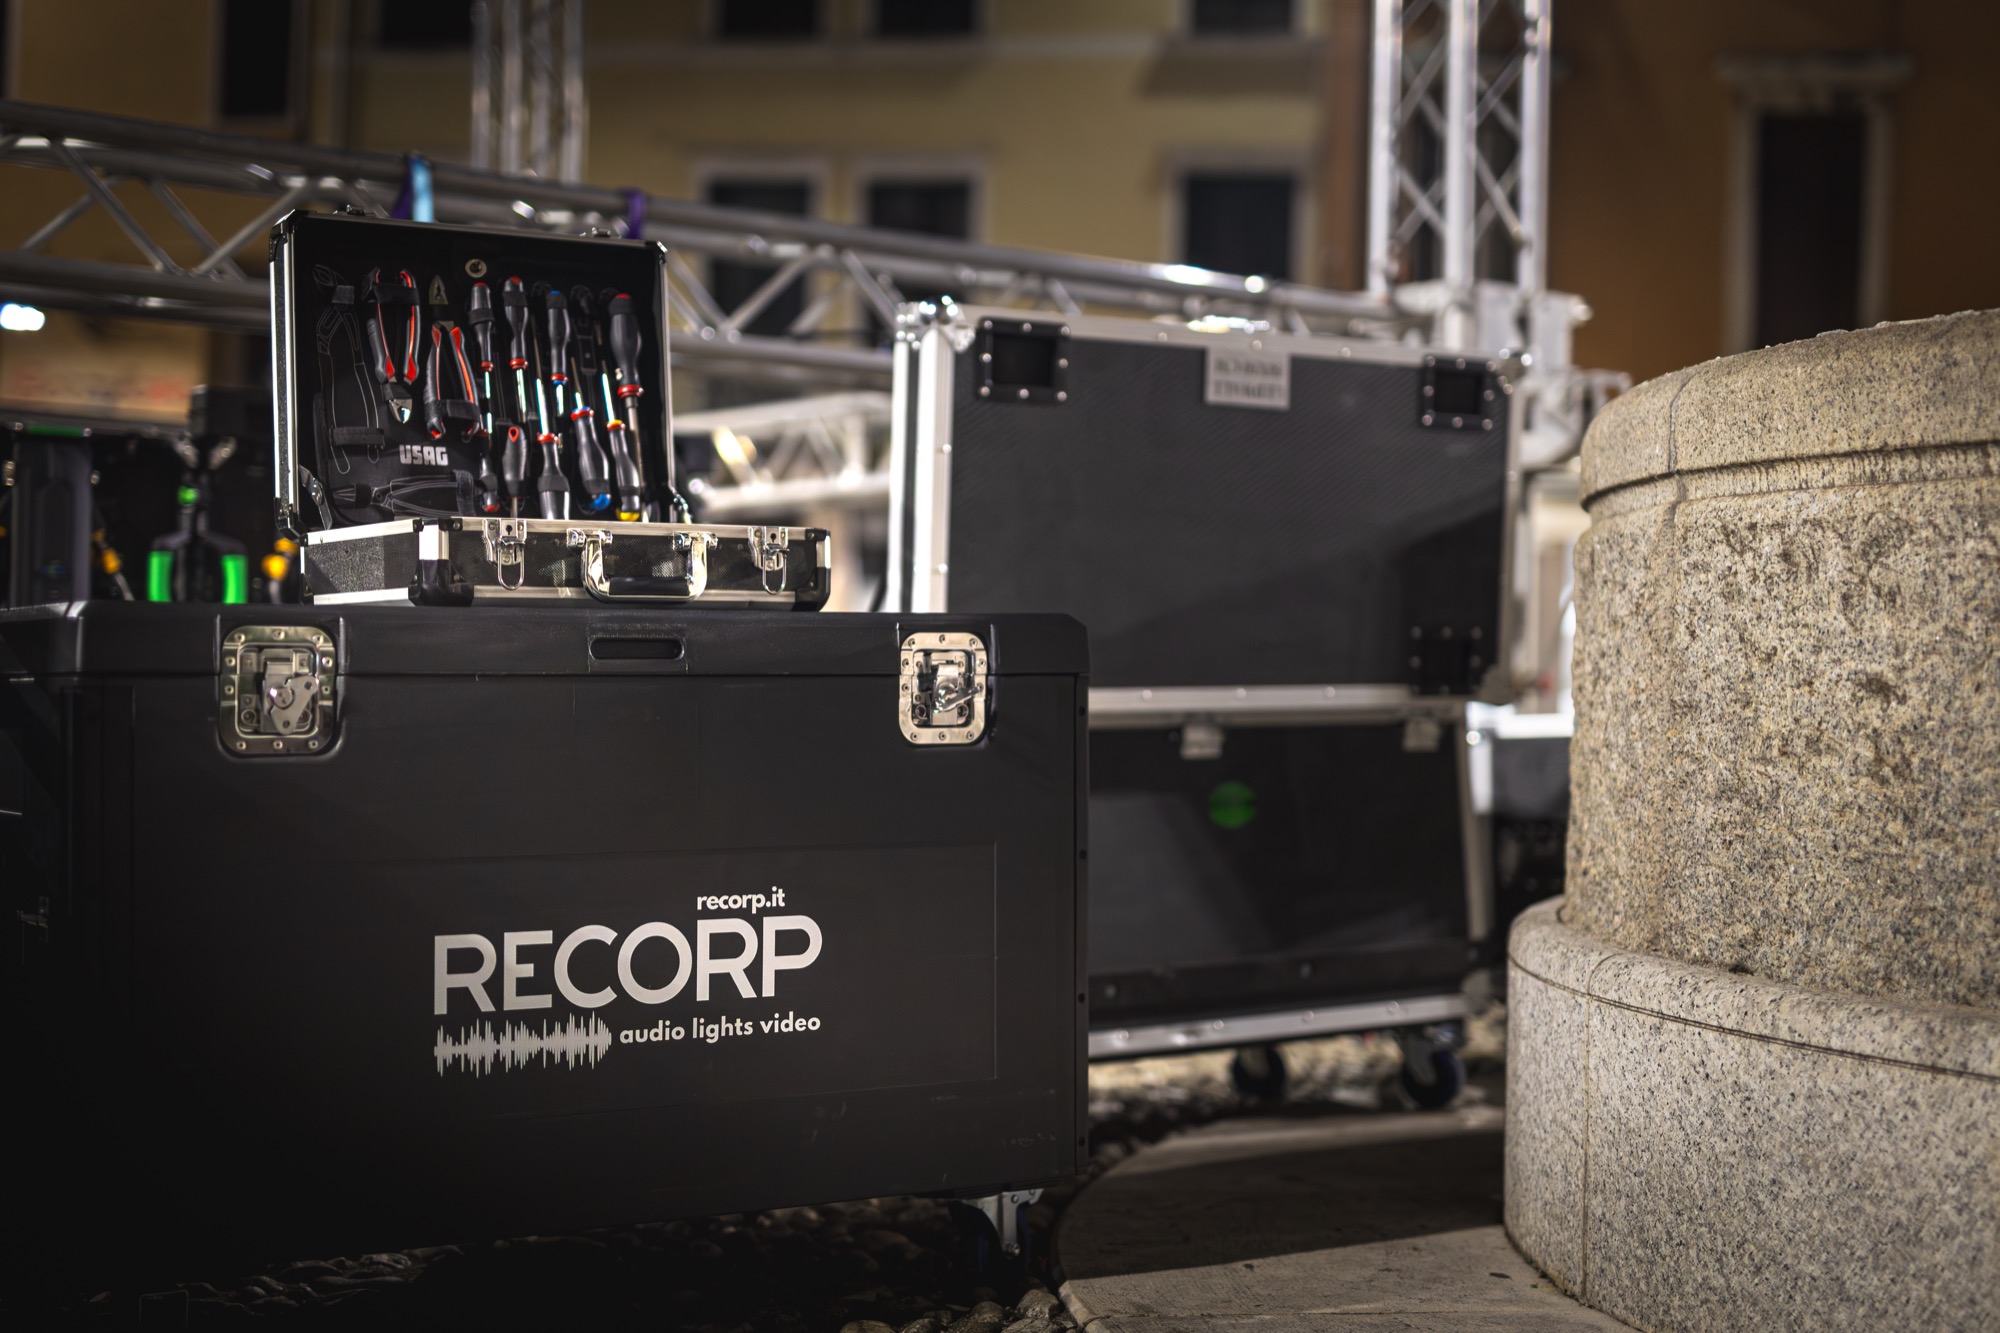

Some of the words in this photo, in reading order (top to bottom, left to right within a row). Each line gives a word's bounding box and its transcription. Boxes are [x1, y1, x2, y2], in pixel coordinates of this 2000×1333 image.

[399, 444, 449, 466] USAG
[696, 885, 786, 915] recorp.it
[433, 914, 823, 1016] RECORP
[619, 1019, 686, 1044] audio
[692, 1015, 754, 1045] lights
[759, 1010, 821, 1034] video
